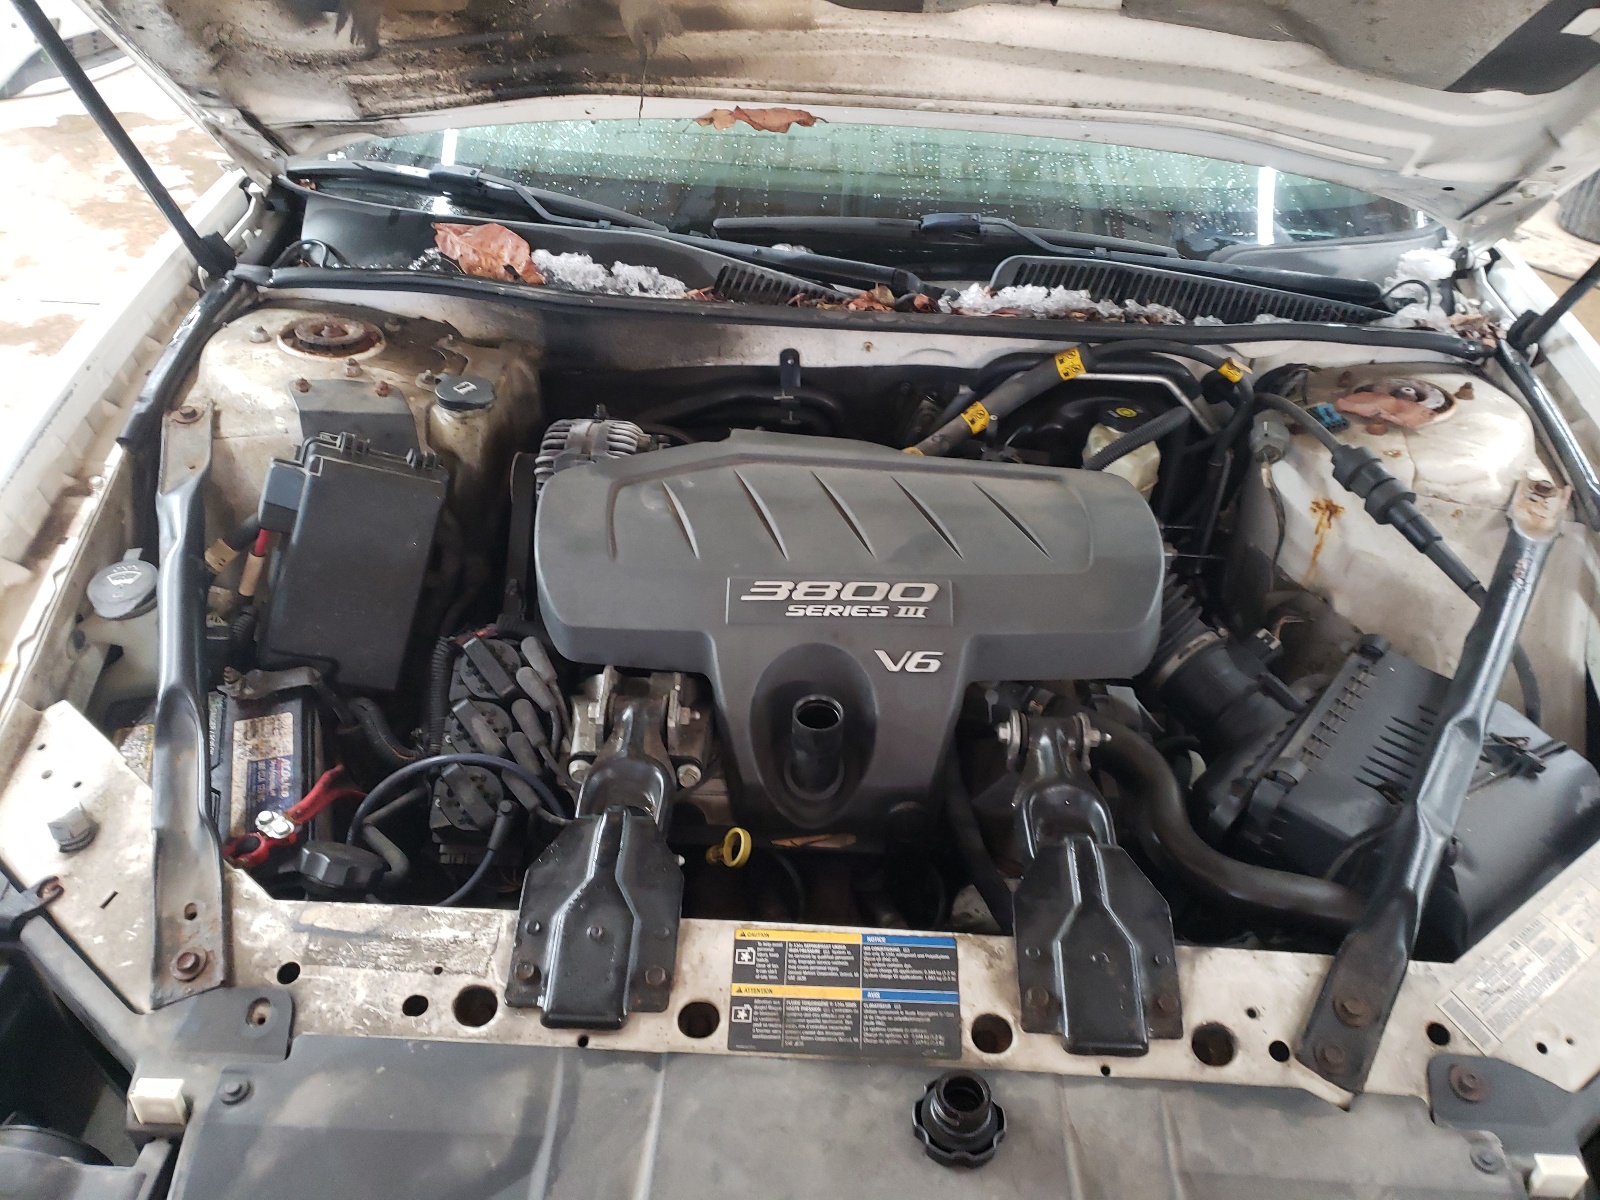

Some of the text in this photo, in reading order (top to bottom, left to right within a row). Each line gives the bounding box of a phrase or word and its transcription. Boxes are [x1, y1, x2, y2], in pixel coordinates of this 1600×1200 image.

[741, 581, 939, 602] 3800
[785, 604, 929, 618] SERIES III
[874, 650, 944, 673] V6
[867, 935, 886, 943] NOTICE
